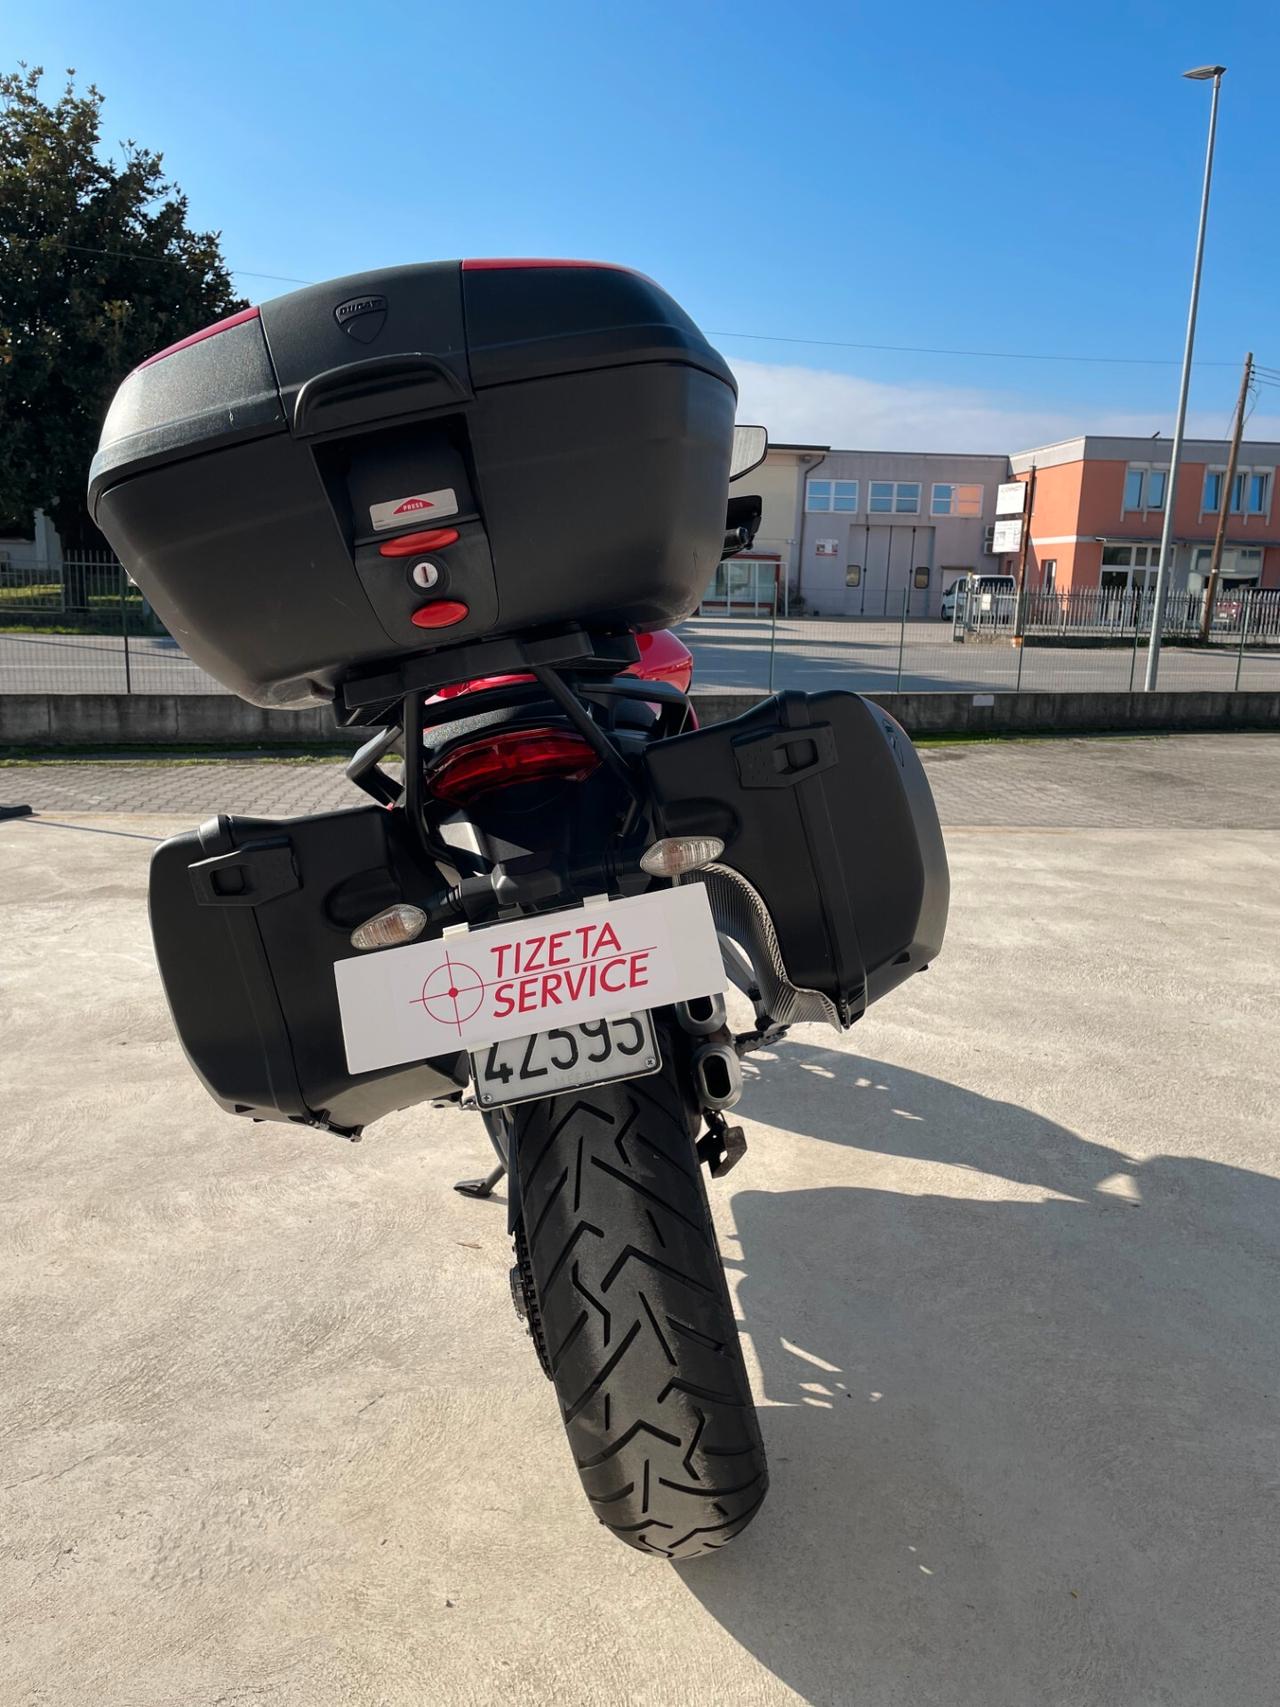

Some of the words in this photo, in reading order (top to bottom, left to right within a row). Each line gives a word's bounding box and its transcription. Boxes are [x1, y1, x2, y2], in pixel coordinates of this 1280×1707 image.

[402, 501, 423, 511] PRESS
[491, 922, 621, 978] TIZETA
[493, 953, 649, 1018] SERVICE
